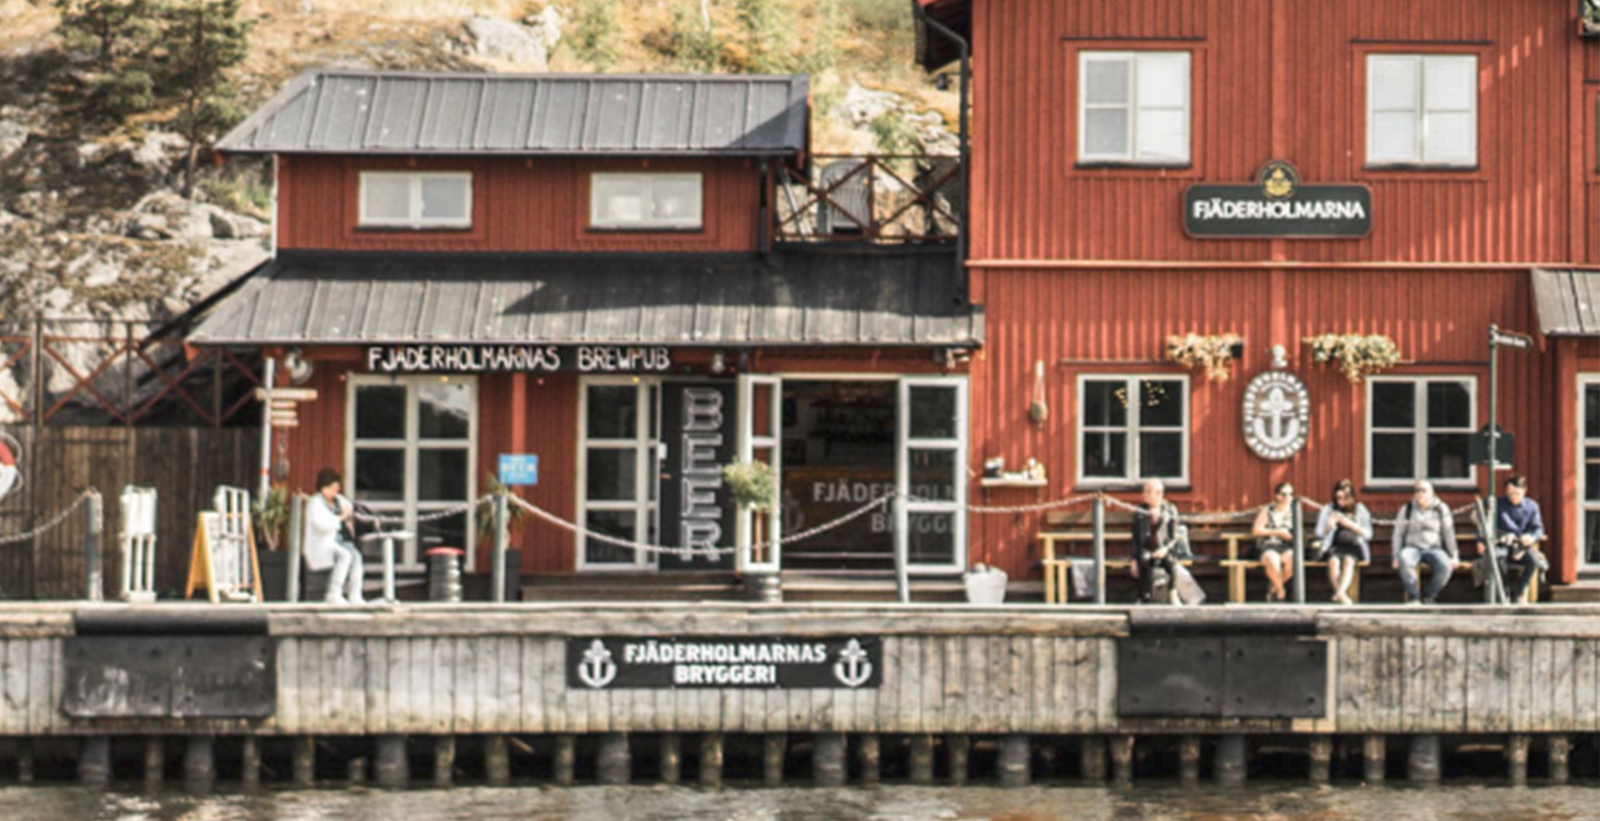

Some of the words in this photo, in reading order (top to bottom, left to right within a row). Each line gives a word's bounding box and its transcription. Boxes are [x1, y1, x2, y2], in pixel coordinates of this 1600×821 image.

[1193, 197, 1365, 220] FJÄDERHOLMARNA
[577, 345, 670, 371] BREWPUB
[680, 387, 724, 562] BEER
[624, 640, 827, 664] FJÄDERHOLMARNAS
[674, 665, 776, 684] BRYGGERI
